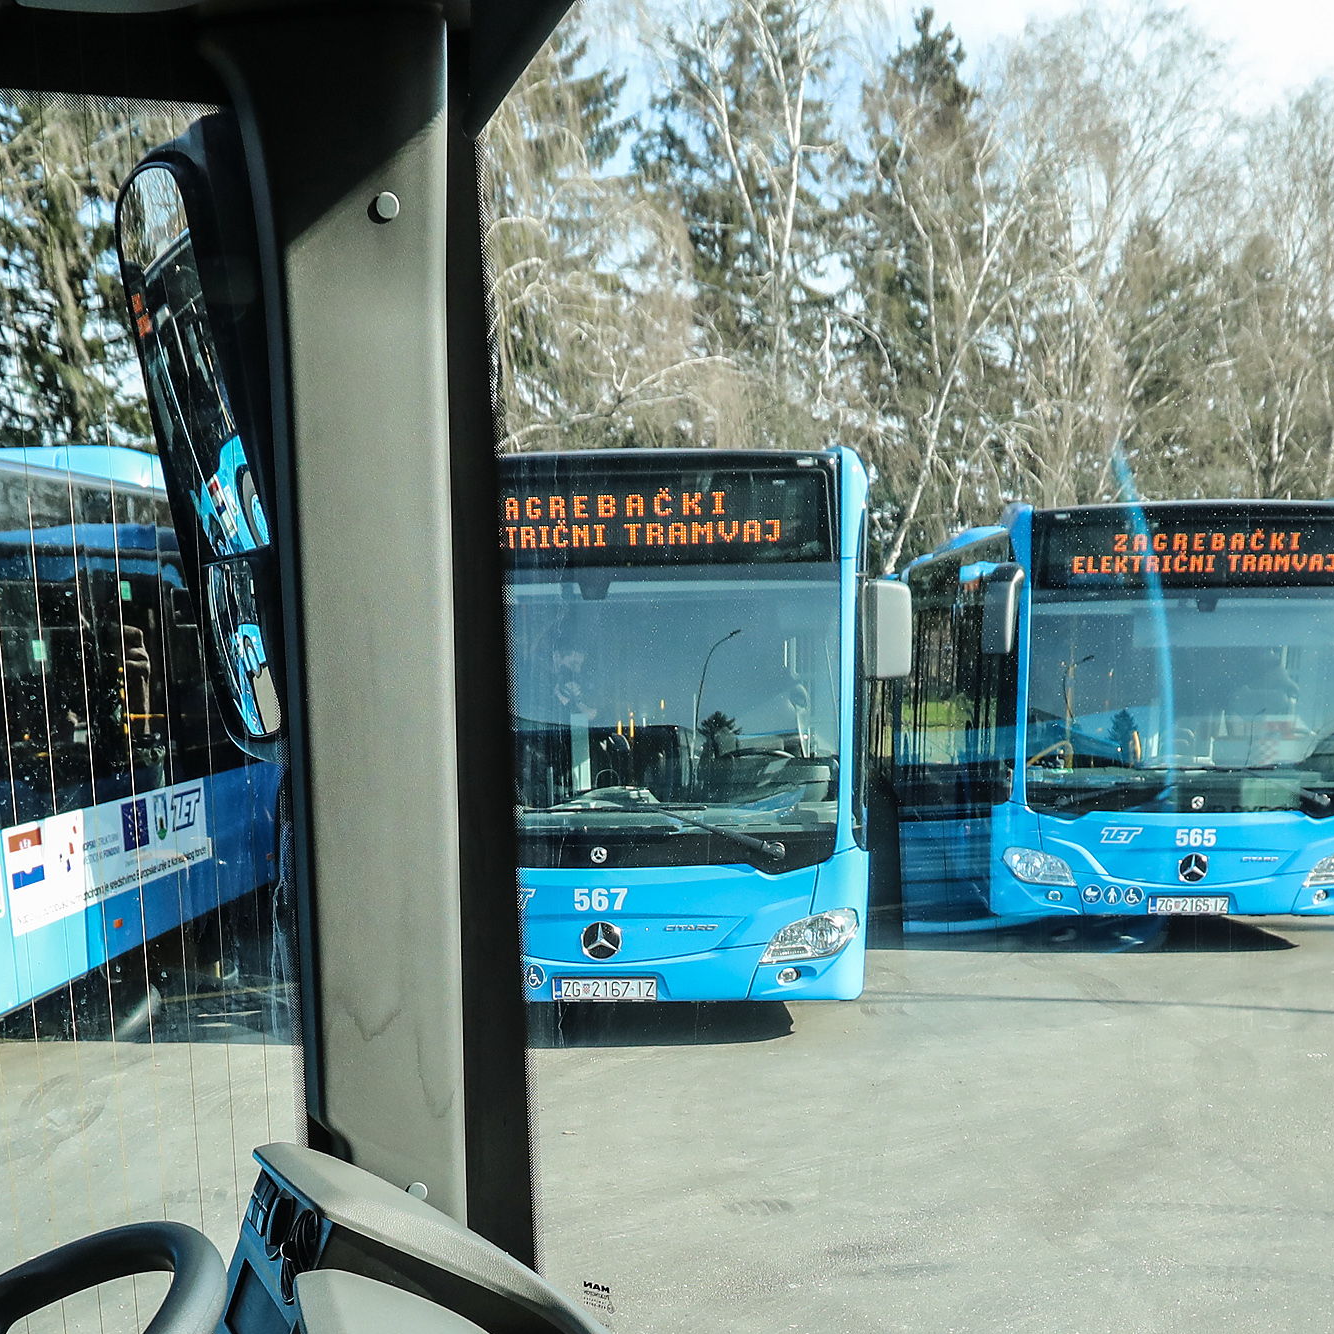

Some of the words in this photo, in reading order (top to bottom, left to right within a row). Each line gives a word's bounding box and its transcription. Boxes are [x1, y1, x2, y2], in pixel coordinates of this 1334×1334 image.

[505, 488, 726, 520] AGREBAČKI
[504, 520, 607, 549] TRIČNI
[624, 519, 781, 546] TRAMVAJ
[1113, 528, 1302, 552] ZAGREBAČKI
[1072, 551, 1216, 574] ELEKTRIČNI
[170, 787, 201, 832] ZET
[1100, 827, 1143, 844] ZET
[1175, 828, 1217, 847] 565
[574, 888, 628, 912] 567
[1157, 899, 1174, 912] ZG
[663, 924, 719, 932] CITARO
[563, 981, 581, 997] ZG
